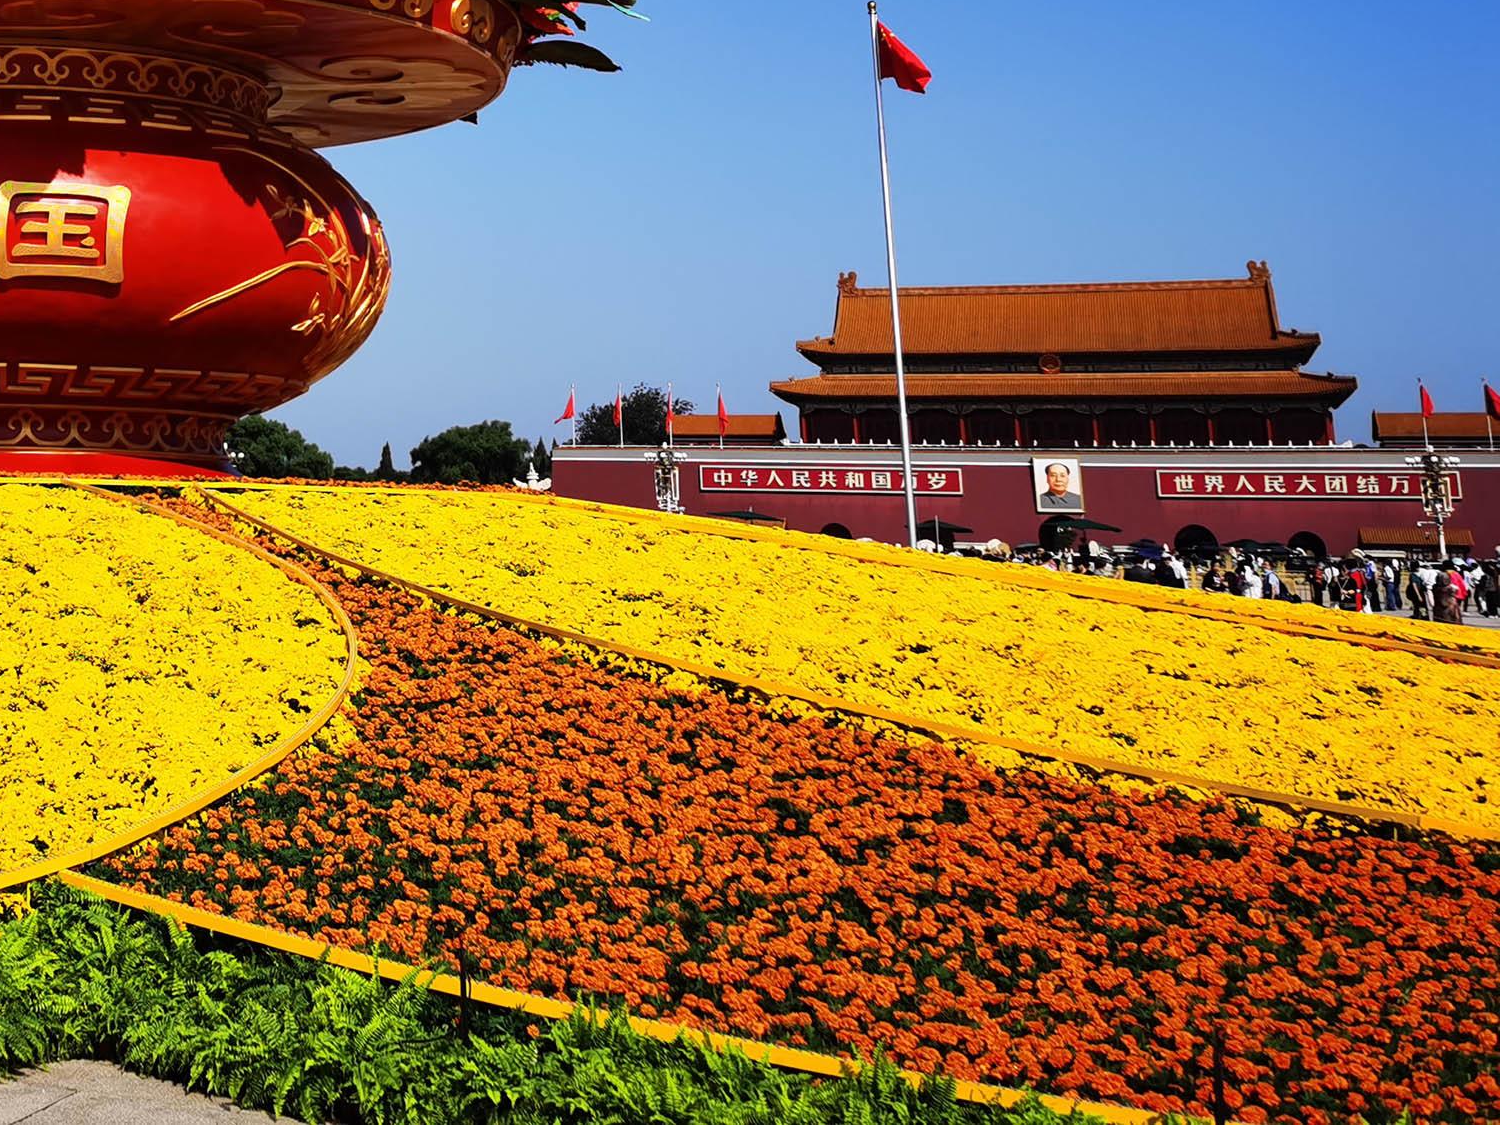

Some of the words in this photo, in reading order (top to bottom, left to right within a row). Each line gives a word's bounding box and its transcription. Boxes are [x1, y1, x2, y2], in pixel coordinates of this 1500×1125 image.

[1173, 475, 1440, 495] 世界人民大团结万
